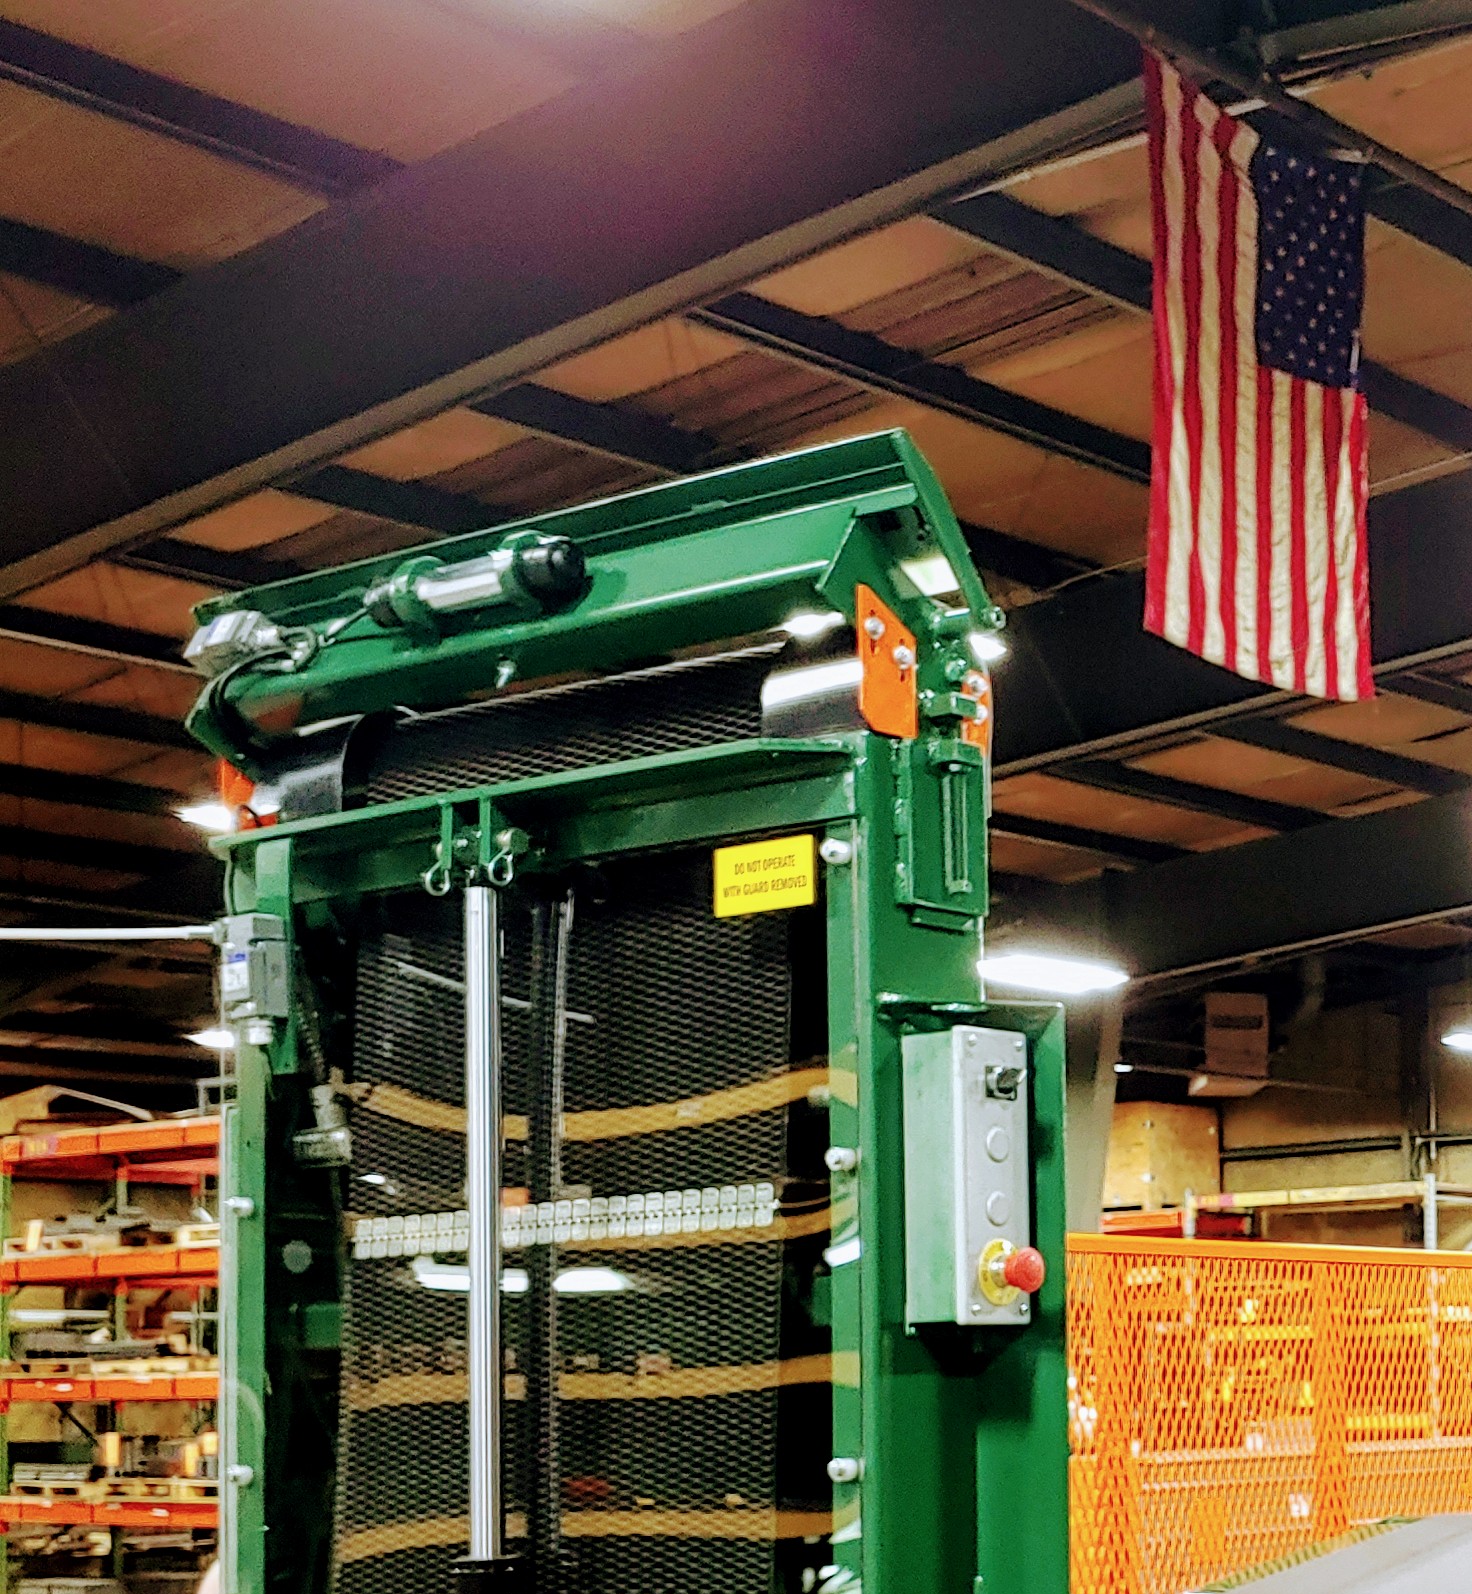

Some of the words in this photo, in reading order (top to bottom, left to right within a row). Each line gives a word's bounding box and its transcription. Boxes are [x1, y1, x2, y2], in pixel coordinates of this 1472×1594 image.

[734, 862, 745, 875] DO
[747, 859, 761, 873] NOT
[763, 854, 796, 871] OPERATE
[723, 885, 741, 898] WITH
[743, 880, 769, 896] GUARD
[771, 875, 808, 892] REMOVED
